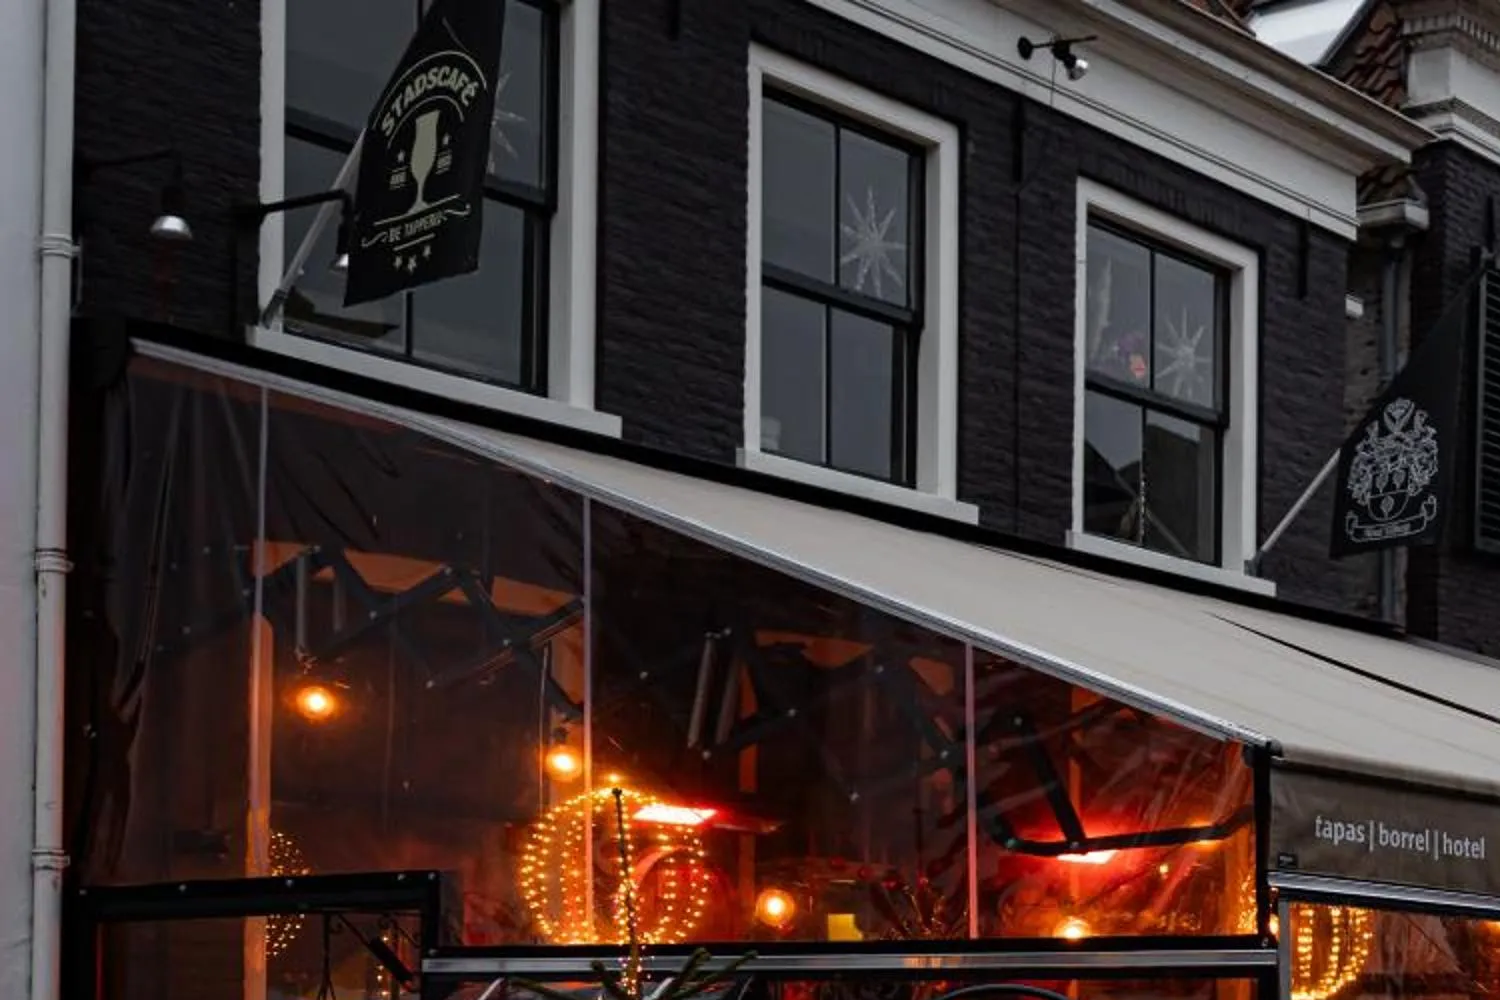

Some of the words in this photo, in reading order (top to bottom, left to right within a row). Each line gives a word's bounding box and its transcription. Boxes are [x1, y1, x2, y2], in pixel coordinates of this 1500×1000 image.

[1314, 815, 1365, 846] tapas
[1379, 822, 1430, 853] borrel
[1443, 832, 1485, 860] hotel
